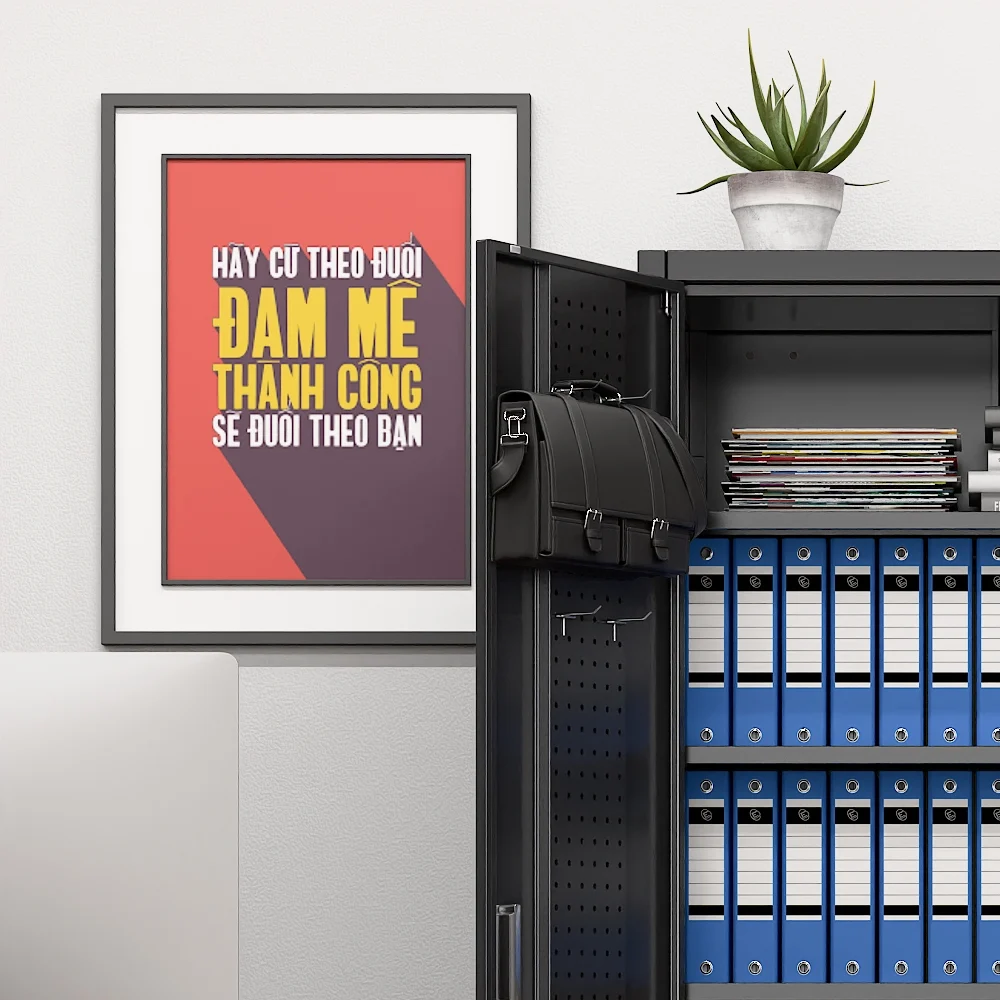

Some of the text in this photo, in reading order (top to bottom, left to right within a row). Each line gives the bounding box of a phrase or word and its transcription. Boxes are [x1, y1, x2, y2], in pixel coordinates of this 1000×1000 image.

[212, 242, 260, 278] HÃY
[307, 246, 364, 278] THEO
[370, 232, 422, 278] ĐUỔI
[212, 279, 422, 358] ĐAM MÊ
[338, 358, 422, 410] CÔNG
[212, 401, 422, 451] SẼ ĐUỔI THEO BẠN
